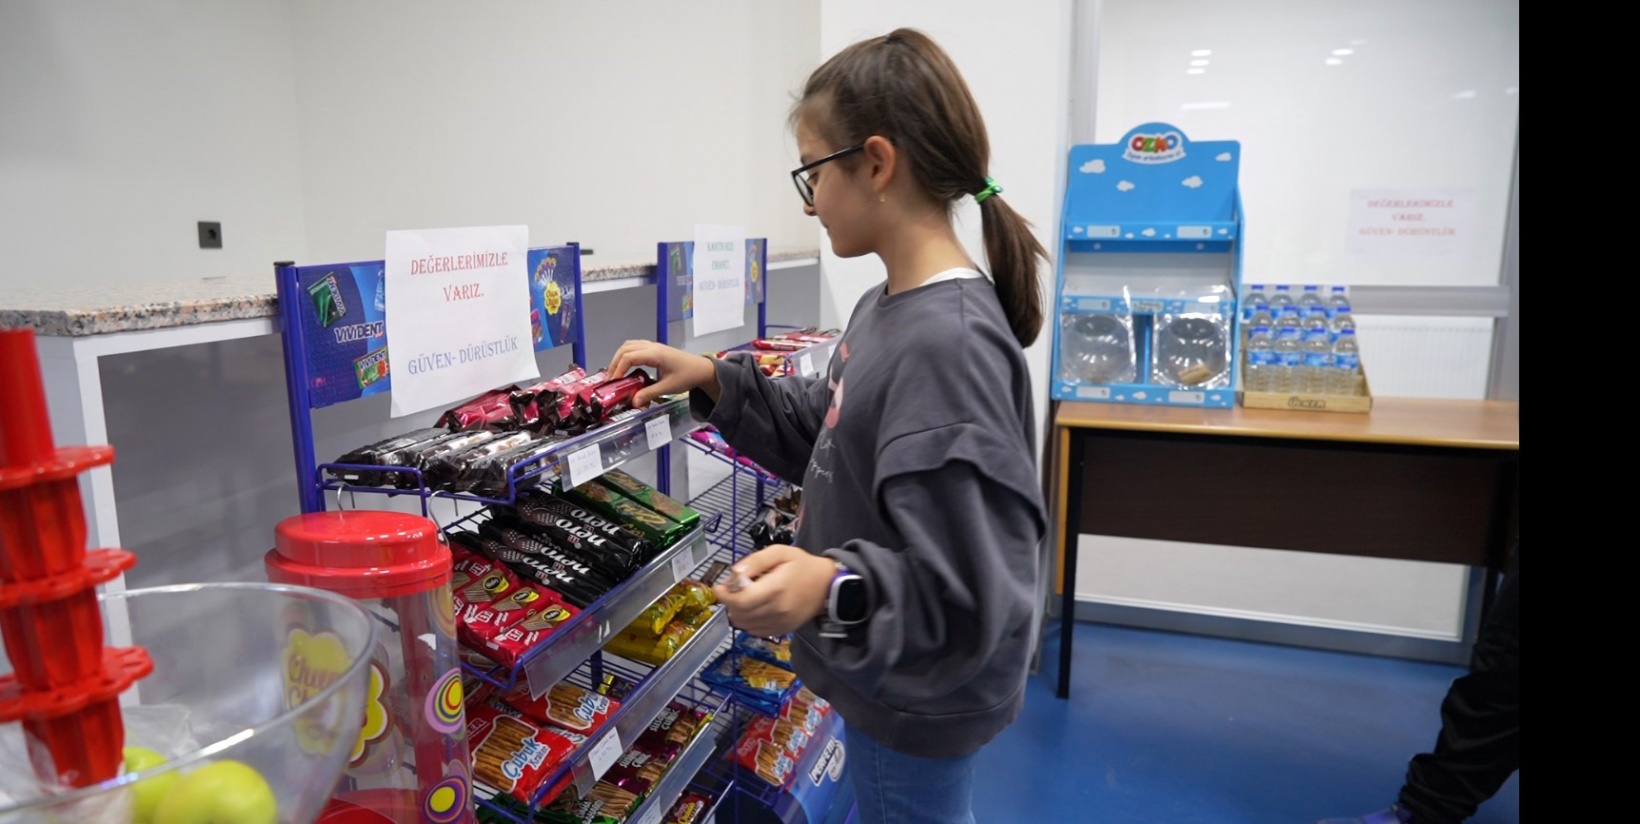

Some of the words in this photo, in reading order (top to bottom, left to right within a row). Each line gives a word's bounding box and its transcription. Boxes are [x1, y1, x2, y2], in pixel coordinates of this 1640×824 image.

[1131, 134, 1179, 153] OZMO
[410, 251, 509, 275] DEĞERLERİMİZLE
[443, 283, 485, 302] VARIZ.
[407, 352, 456, 375] GÜVEN-
[458, 335, 518, 363] DÜRÜSTLÜK
[555, 519, 607, 547] nero
[570, 509, 621, 536] nero
[522, 557, 575, 583] nero
[540, 546, 590, 575] nero
[502, 737, 540, 778] Çubuk
